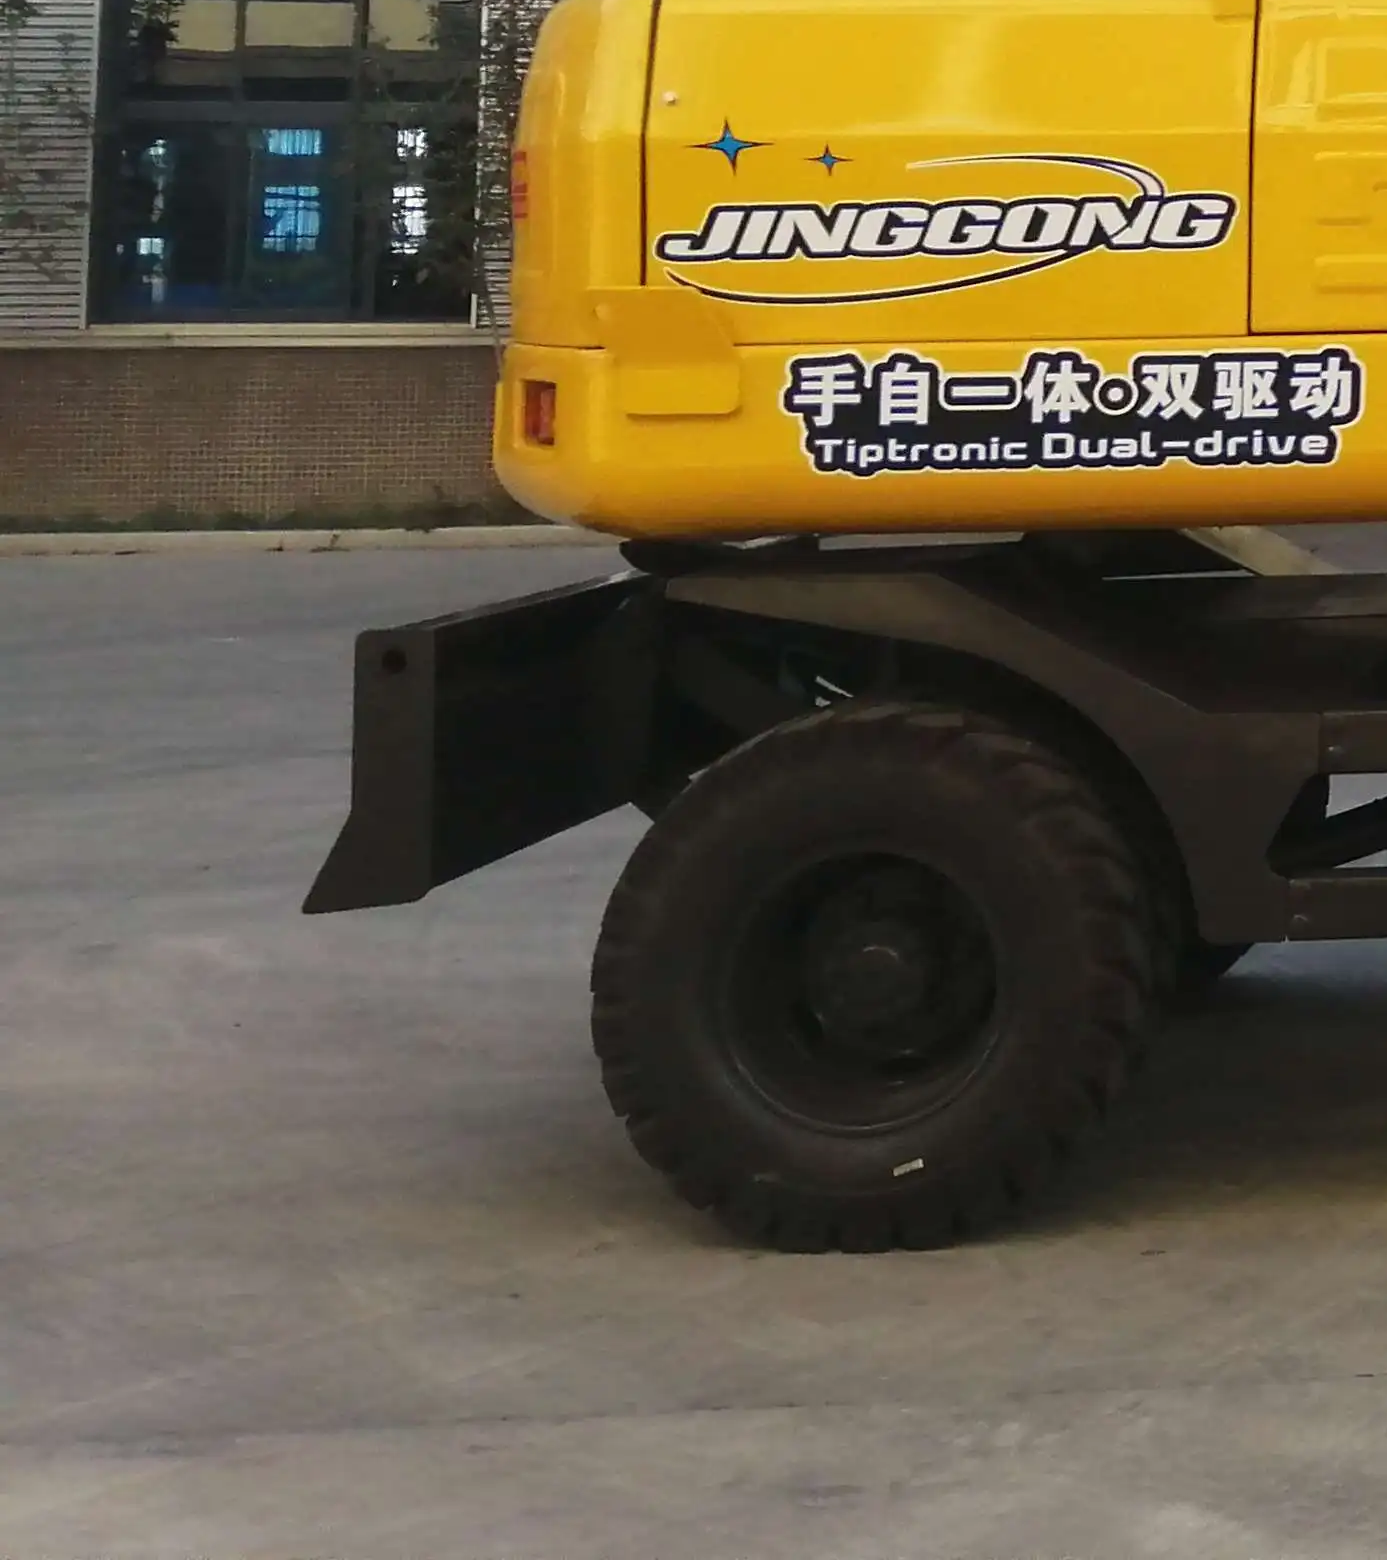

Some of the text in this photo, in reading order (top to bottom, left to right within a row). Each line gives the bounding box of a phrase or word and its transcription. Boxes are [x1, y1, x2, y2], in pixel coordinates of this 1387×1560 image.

[661, 197, 1233, 258] JINGGONG
[813, 431, 1330, 469] Tiptronic Dual-drive
